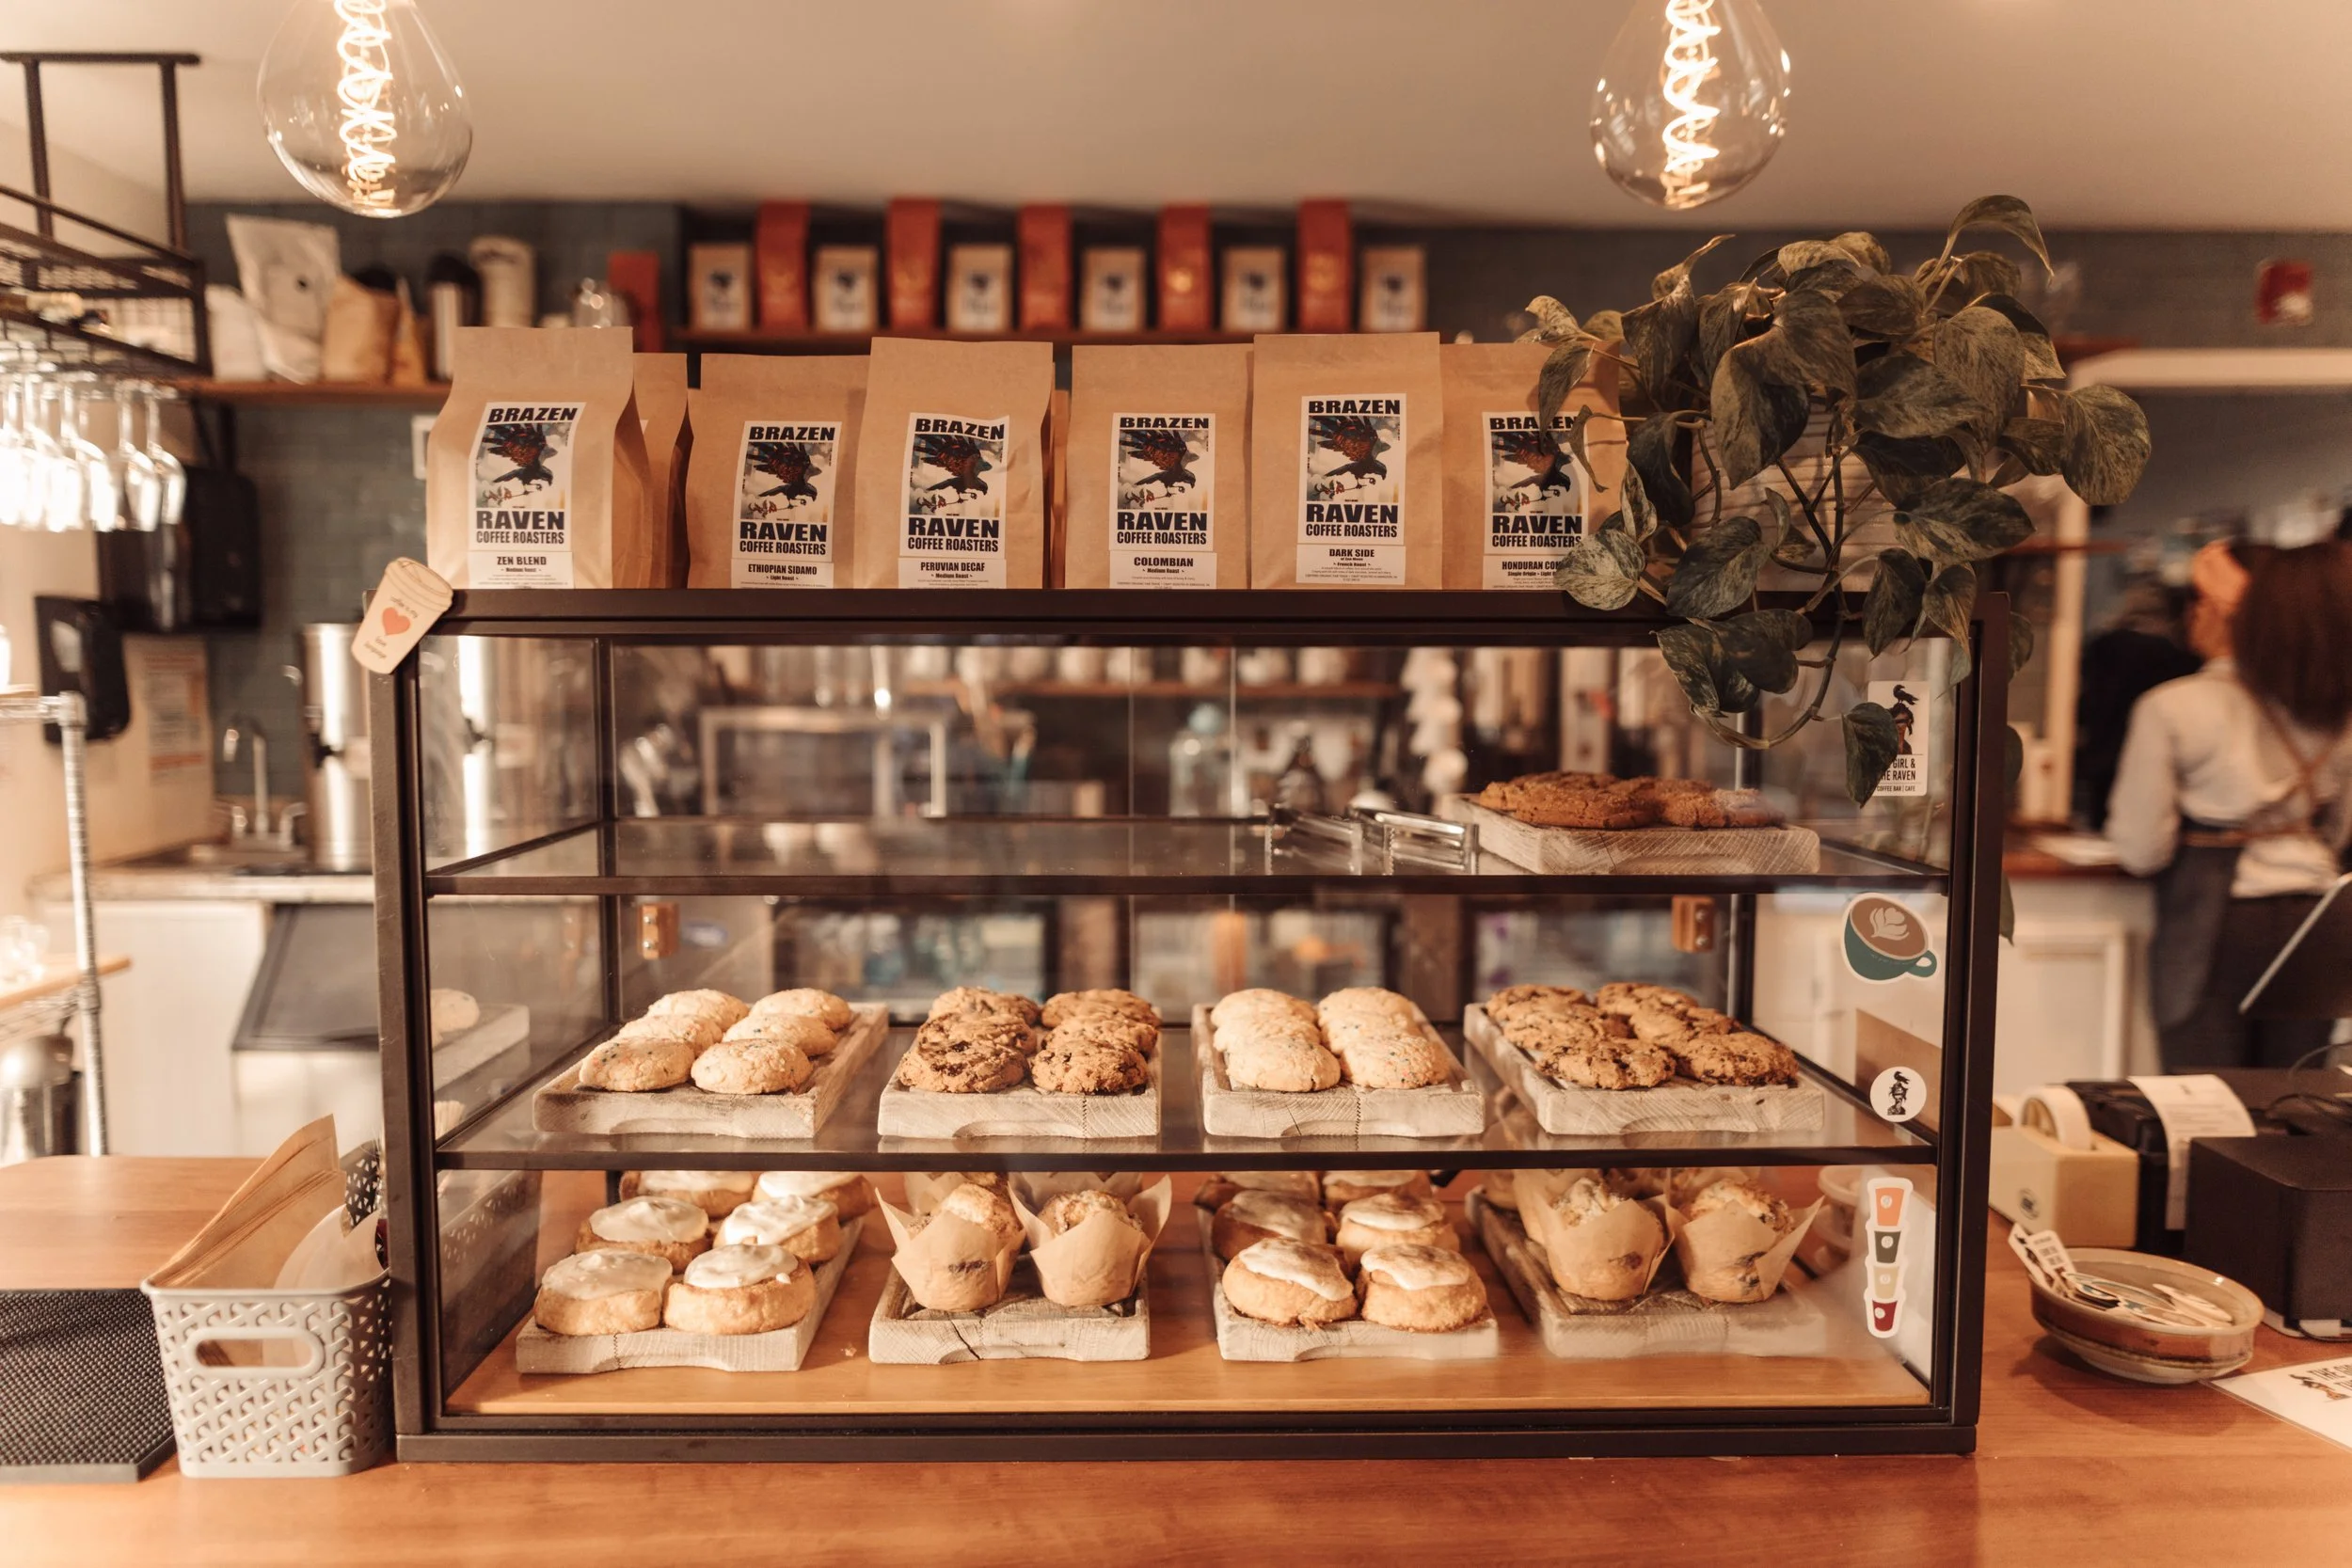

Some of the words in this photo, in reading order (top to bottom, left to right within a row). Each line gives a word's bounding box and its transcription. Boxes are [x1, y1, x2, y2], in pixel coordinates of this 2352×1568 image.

[1309, 400, 1400, 414] BRAZEN
[487, 407, 578, 422] BRAZEN
[914, 419, 1005, 440] BRAZEN
[1120, 417, 1209, 429] BRAZEN
[1489, 416, 1577, 430] BRAEN
[749, 426, 835, 441] BRAZEN
[1306, 503, 1398, 523] RAVEN
[476, 511, 564, 530] RAVEN
[908, 517, 999, 538] RAVEN
[1117, 511, 1207, 531] RAVEN
[1492, 515, 1582, 534] RAVEN
[476, 531, 510, 544] COFFEE
[513, 531, 564, 544] ROASTERS
[740, 521, 827, 542] RAVEN
[1306, 524, 1342, 536] COFFEE
[1343, 524, 1397, 537] ROASTERS
[908, 537, 944, 550] COFFEE
[946, 538, 998, 552] ROASTERS
[1117, 531, 1152, 544] COFFEE
[1154, 531, 1207, 545] ROASTERS
[1492, 534, 1527, 547] COFFEE
[1530, 535, 1581, 547] ROASTERS
[739, 540, 773, 553] COFFEE
[775, 542, 826, 555] ROASTERS
[1329, 548, 1353, 557] DARK
[1355, 549, 1375, 558] SIDE
[497, 556, 514, 565] ZEN
[516, 556, 547, 565] BLEND
[920, 562, 960, 572] PERUVIAN
[961, 562, 985, 572] DECAF
[1134, 557, 1194, 566] COLOMBIAN
[1502, 561, 1543, 570] HONDURAN
[748, 563, 787, 574] ETHIOPIAN
[787, 565, 818, 575] SIDAMO
[1893, 758, 1908, 768] GIRL
[1911, 758, 1915, 768] &
[1893, 770, 1915, 781] RAVEN
